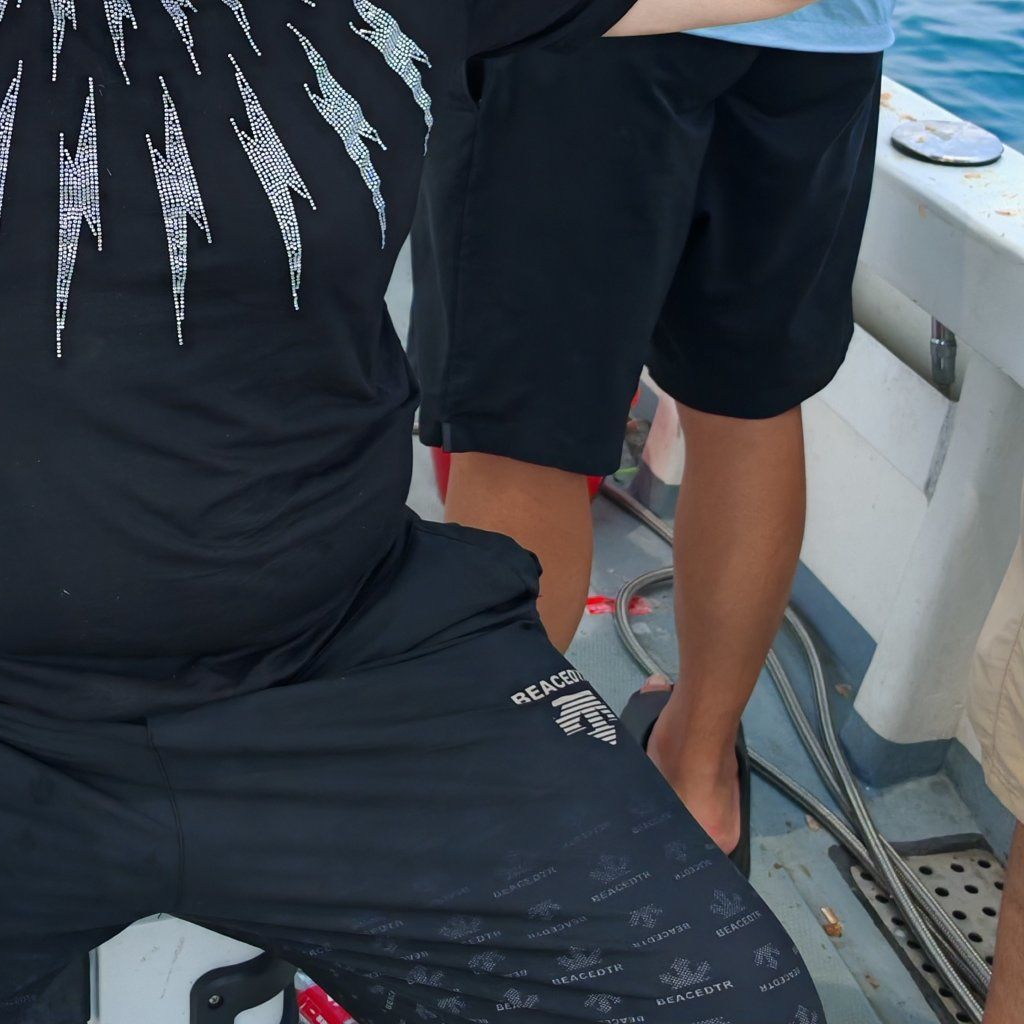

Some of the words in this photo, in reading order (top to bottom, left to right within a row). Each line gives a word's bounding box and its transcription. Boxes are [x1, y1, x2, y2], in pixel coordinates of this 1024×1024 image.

[511, 669, 584, 705] BEACED
[715, 909, 763, 938] BEACEDTR
[551, 963, 625, 986] BEACEDTR
[656, 979, 734, 1007] BEACEDTR
